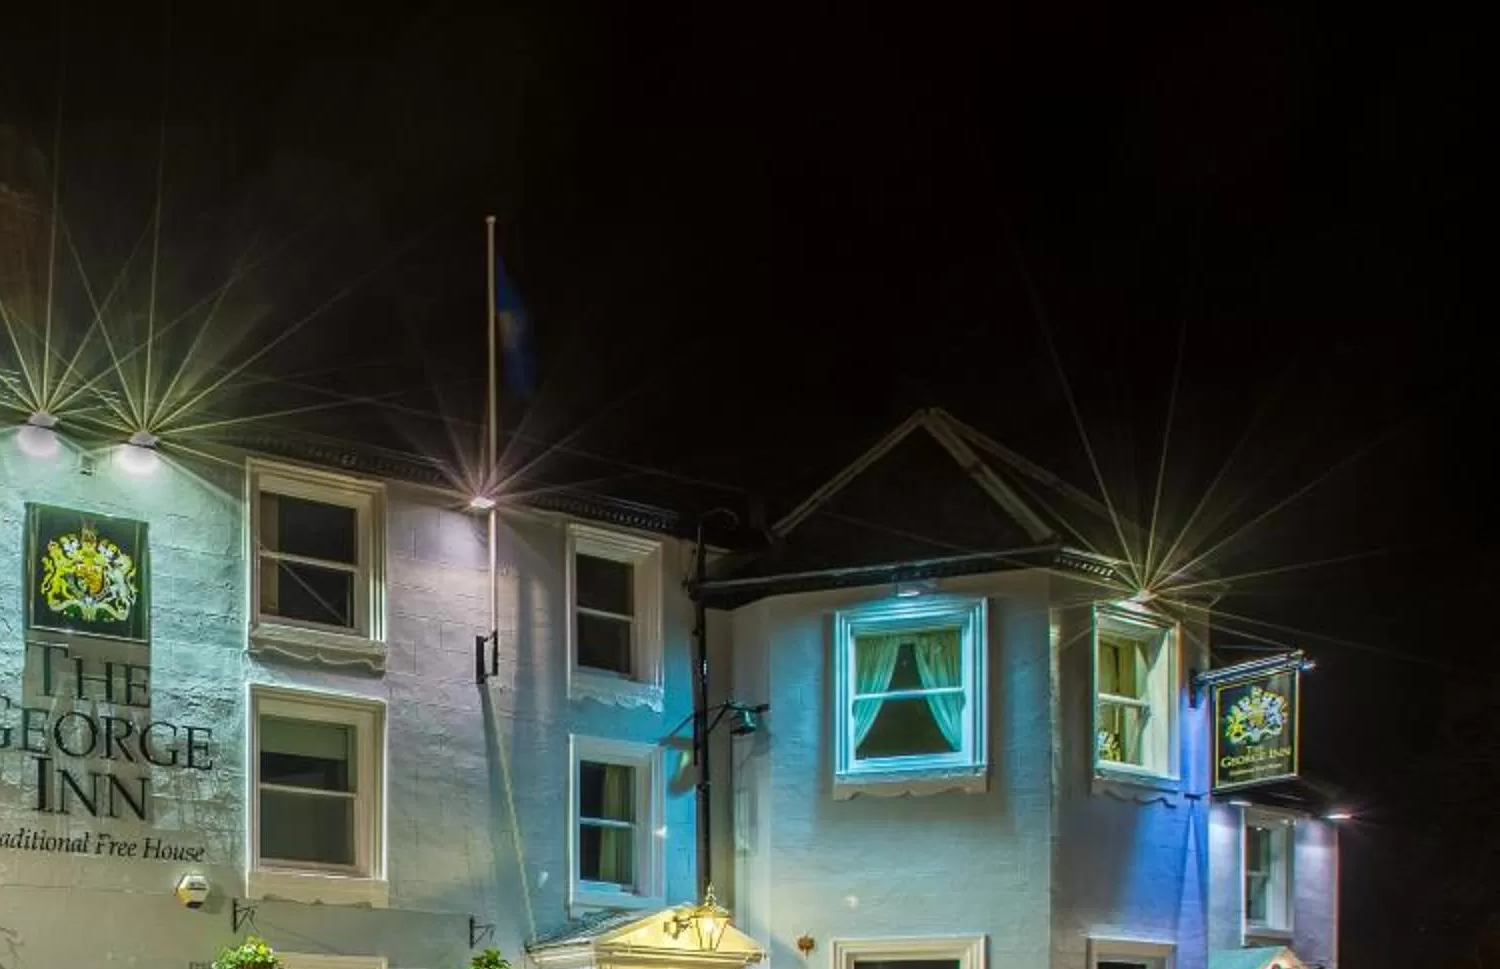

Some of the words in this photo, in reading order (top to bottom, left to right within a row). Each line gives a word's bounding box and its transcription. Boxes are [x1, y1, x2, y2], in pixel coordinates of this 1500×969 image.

[25, 641, 150, 708] THE
[31, 754, 151, 820] INN
[94, 833, 138, 857] Free
[141, 836, 206, 862] House
